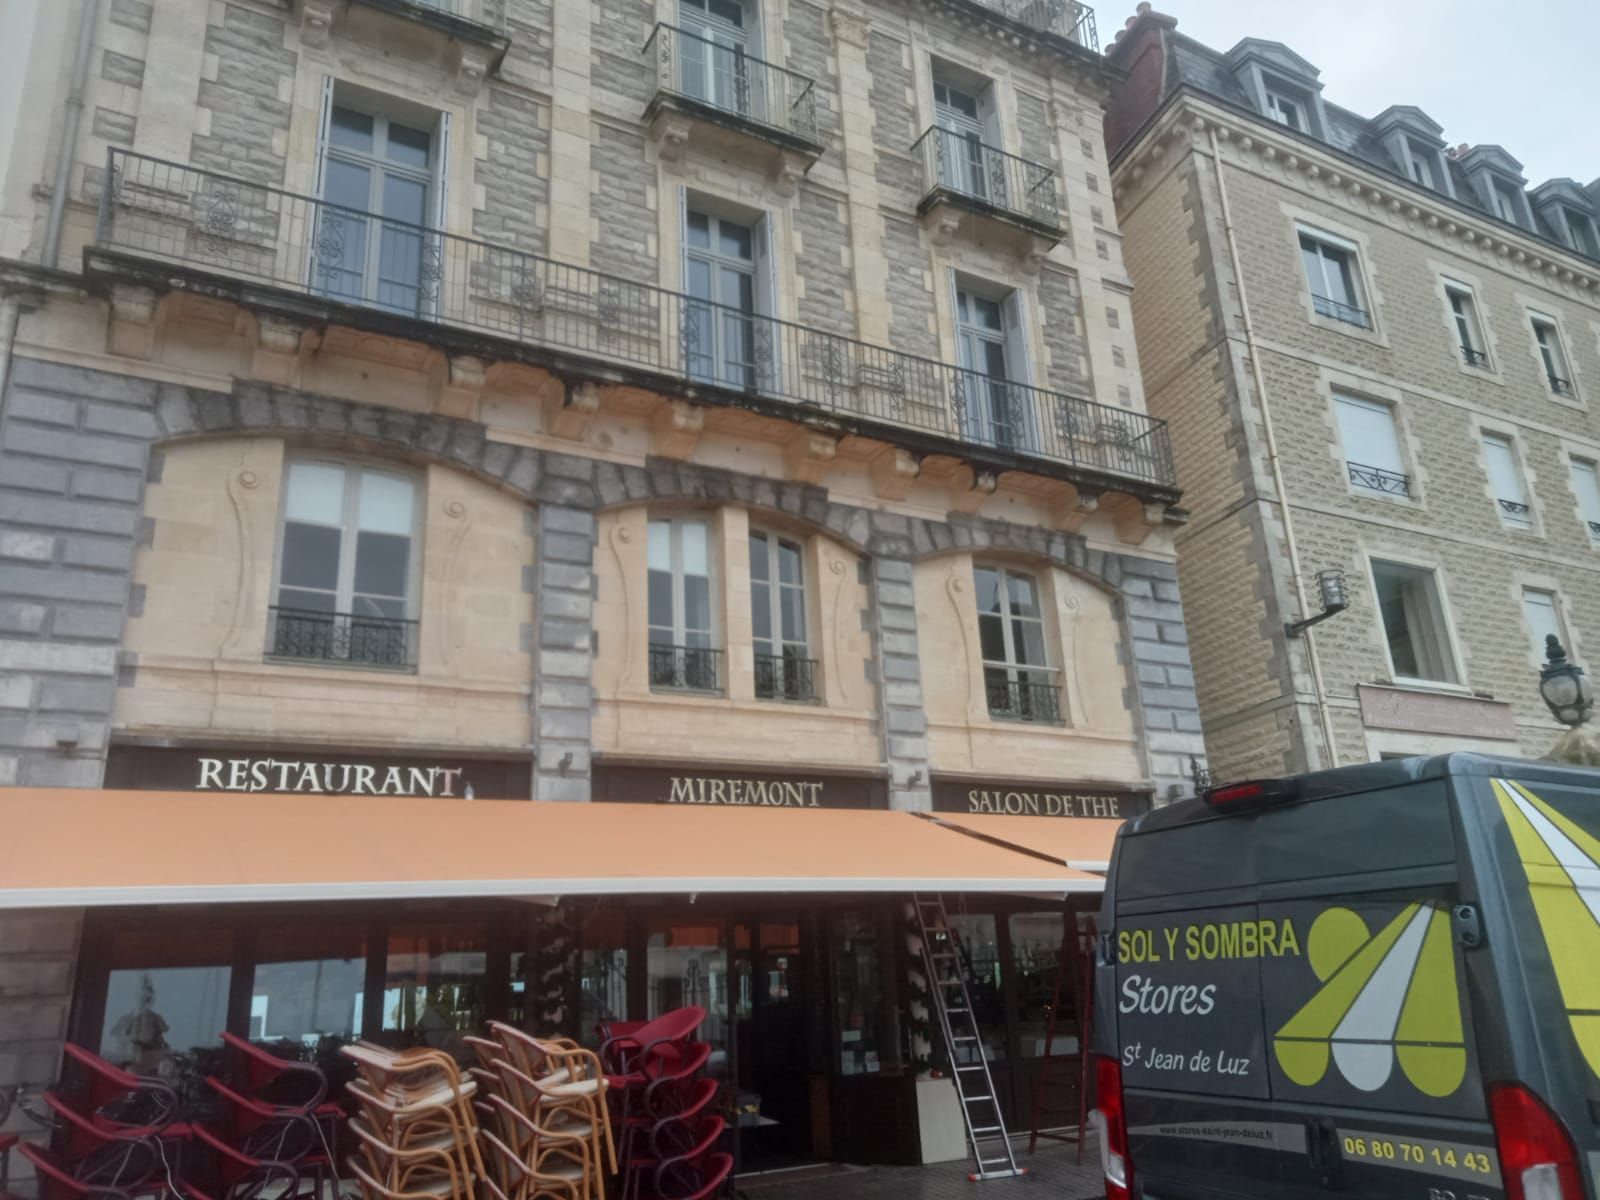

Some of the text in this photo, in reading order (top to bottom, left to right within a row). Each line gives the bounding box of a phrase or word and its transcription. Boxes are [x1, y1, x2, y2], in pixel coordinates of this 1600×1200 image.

[195, 758, 463, 797] RESTAURANT
[669, 777, 823, 807] MIREMONT
[968, 790, 1120, 818] SALON DE THE
[1118, 918, 1300, 964] SOL Y SOMBRA
[1119, 974, 1217, 1015] Stores
[1122, 1042, 1250, 1075] St Jean de Luz
[1344, 1137, 1491, 1174] 06 80 70 14 43
